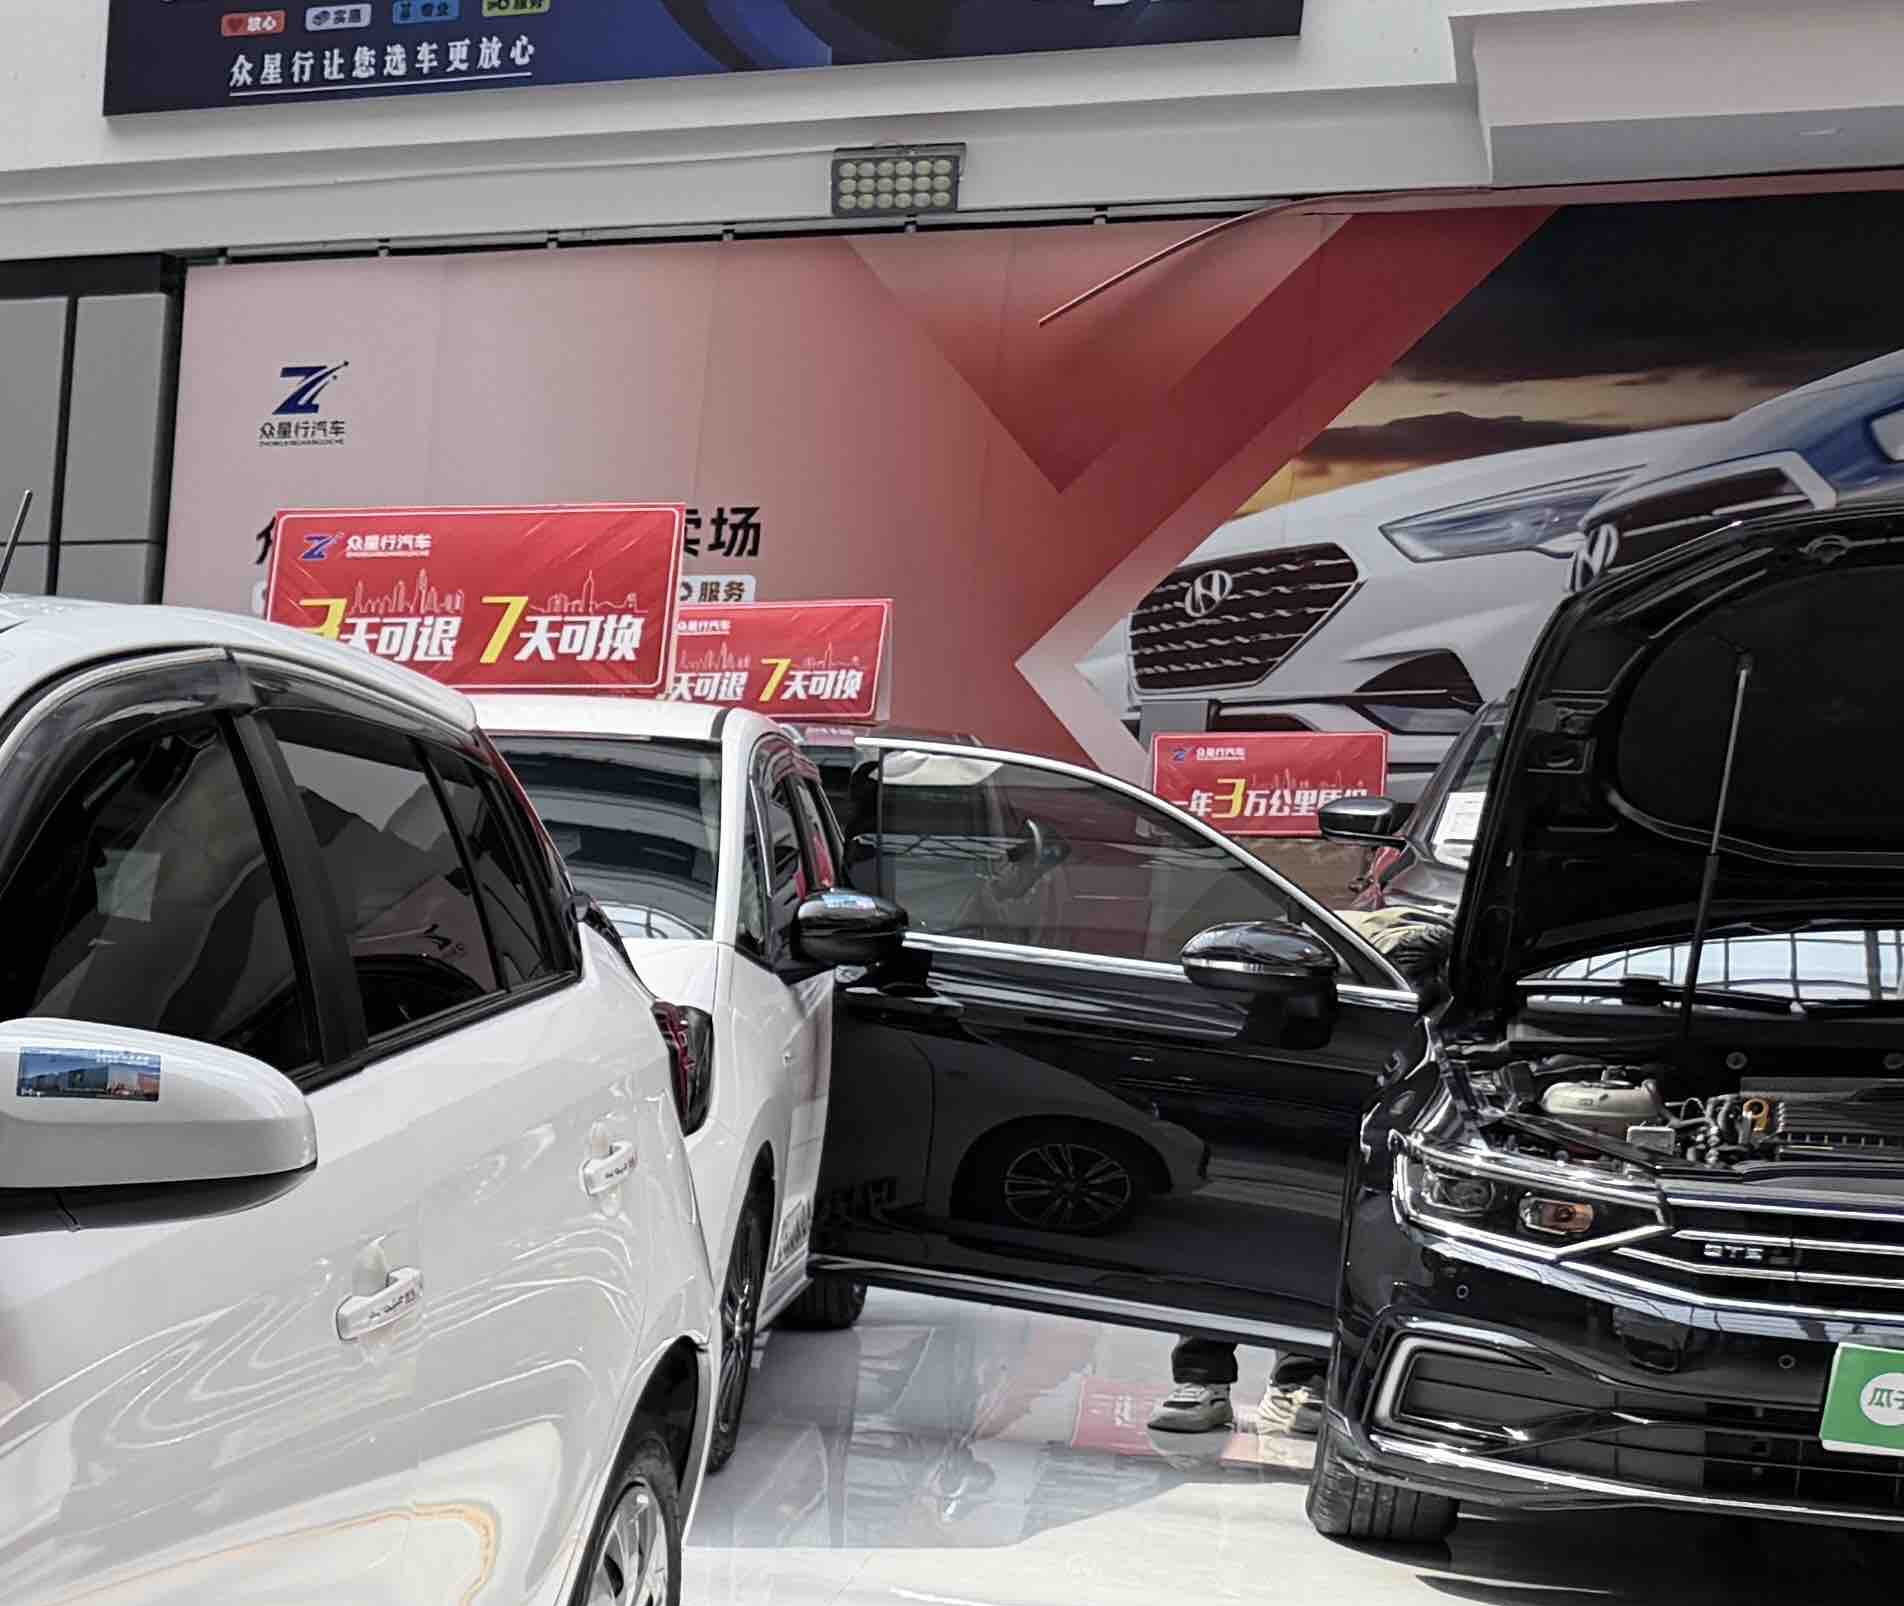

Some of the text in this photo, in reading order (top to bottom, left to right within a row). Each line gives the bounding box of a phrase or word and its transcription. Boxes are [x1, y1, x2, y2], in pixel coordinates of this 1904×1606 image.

[229, 35, 535, 88] 众星行让您选车更放心
[258, 420, 345, 440] 众星行汽车
[345, 533, 432, 552] 众星行汽车
[698, 580, 746, 602] 服务
[481, 595, 643, 664] 7天可换
[666, 656, 865, 702] 天可退 7天可换
[1171, 777, 1368, 819] 一年3万公里
